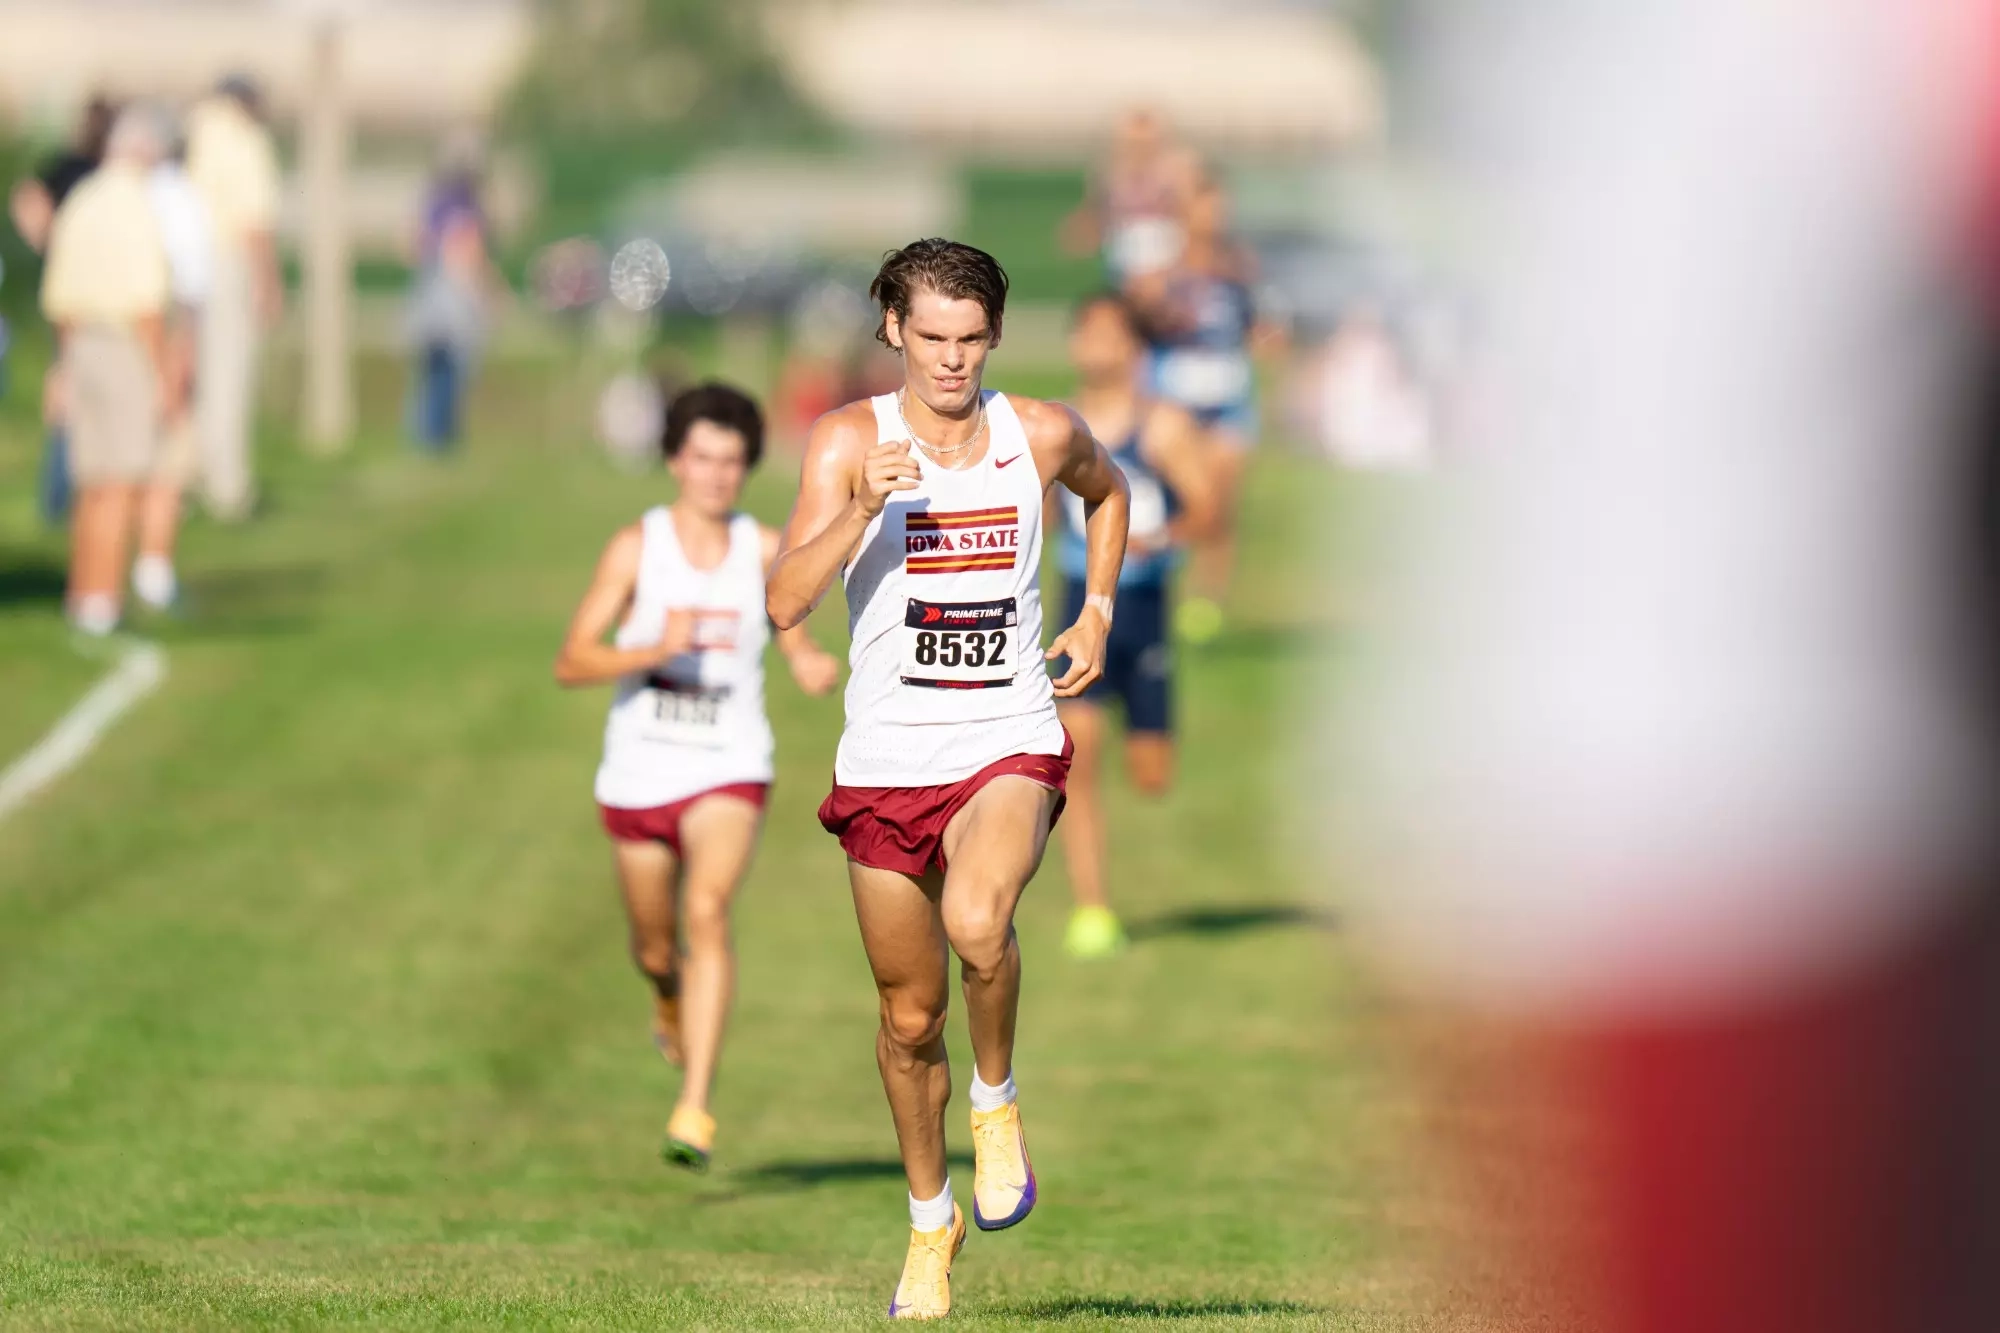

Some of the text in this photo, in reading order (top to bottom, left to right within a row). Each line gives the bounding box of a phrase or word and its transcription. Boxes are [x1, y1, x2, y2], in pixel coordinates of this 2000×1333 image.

[906, 529, 1018, 553] IOWA STATE
[943, 608, 1003, 618] PRIMETIME
[915, 630, 1007, 667] 8532
